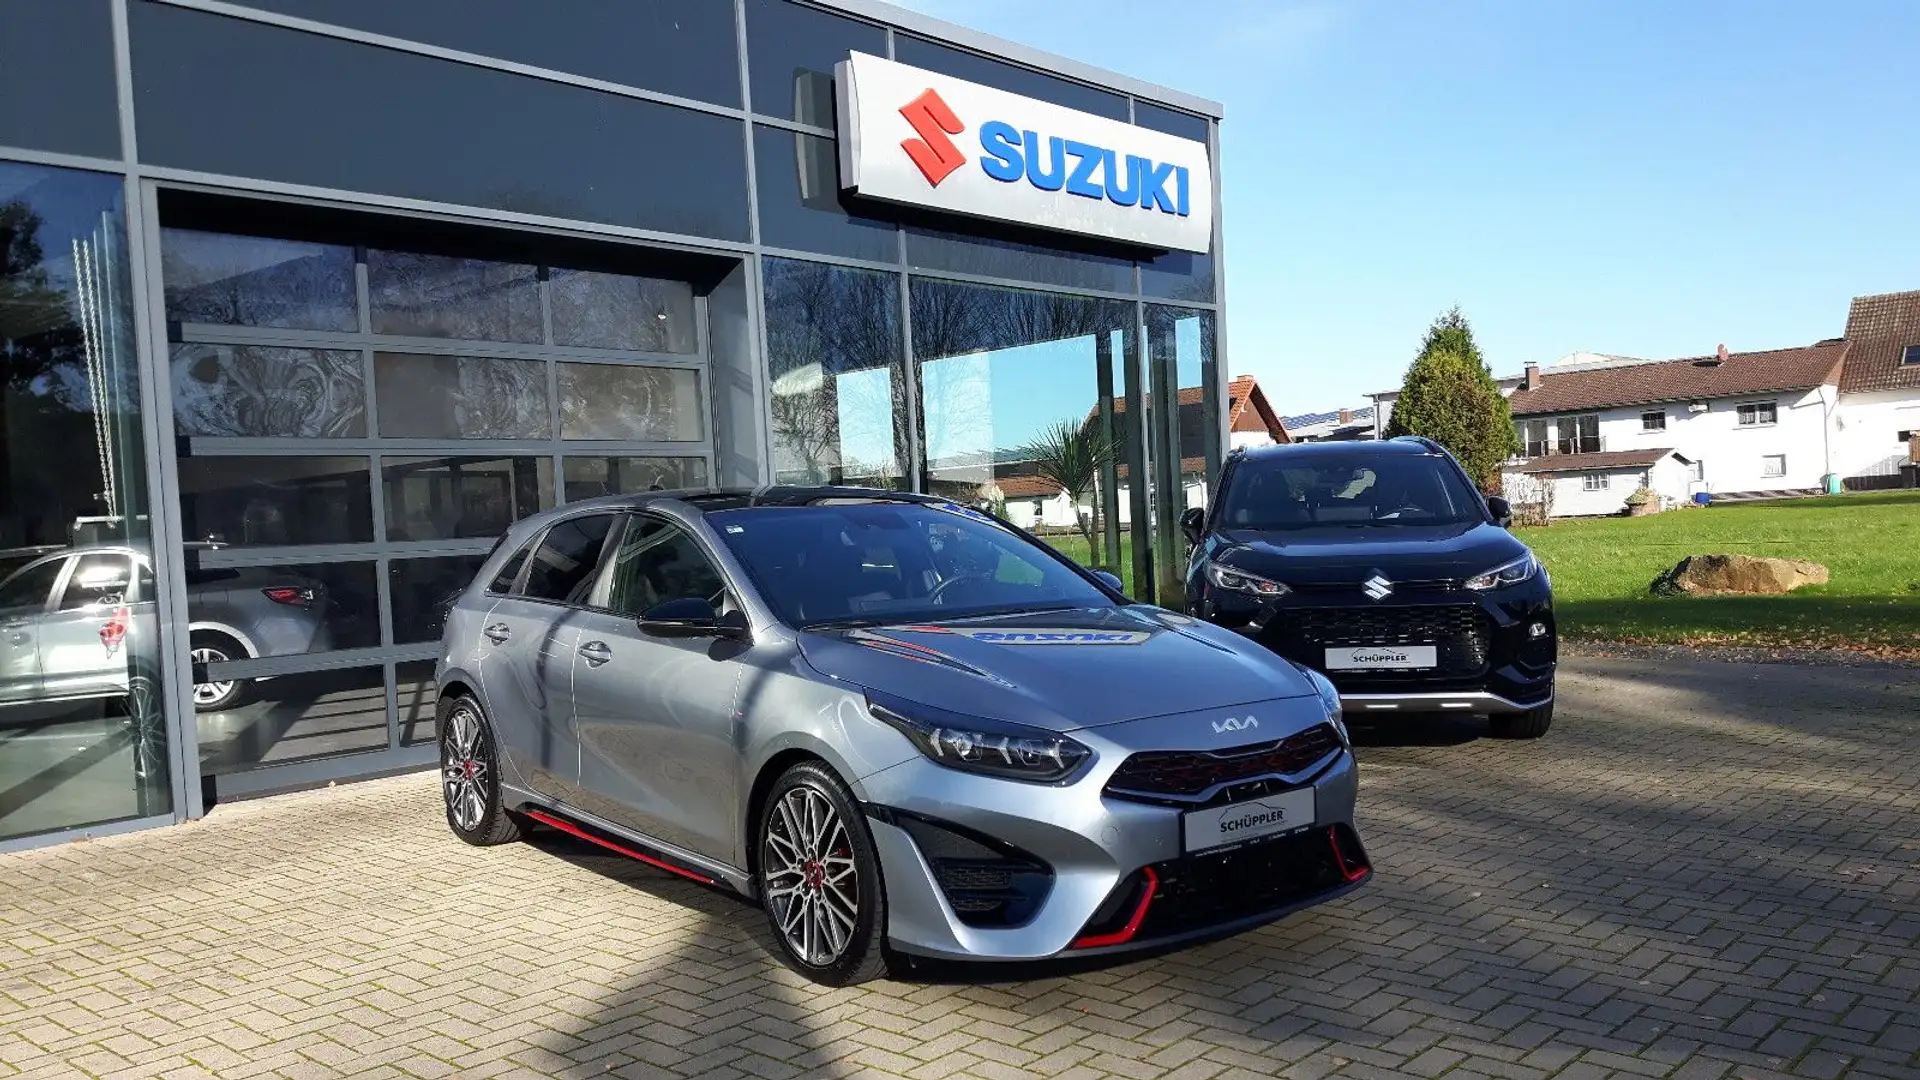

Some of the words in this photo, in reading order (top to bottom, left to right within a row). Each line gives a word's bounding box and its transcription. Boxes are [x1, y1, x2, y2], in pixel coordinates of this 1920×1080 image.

[979, 120, 1190, 216] SUZUKI
[1353, 653, 1407, 663] SCHÜPPLER
[1220, 810, 1284, 833] SCHÜPPLER
